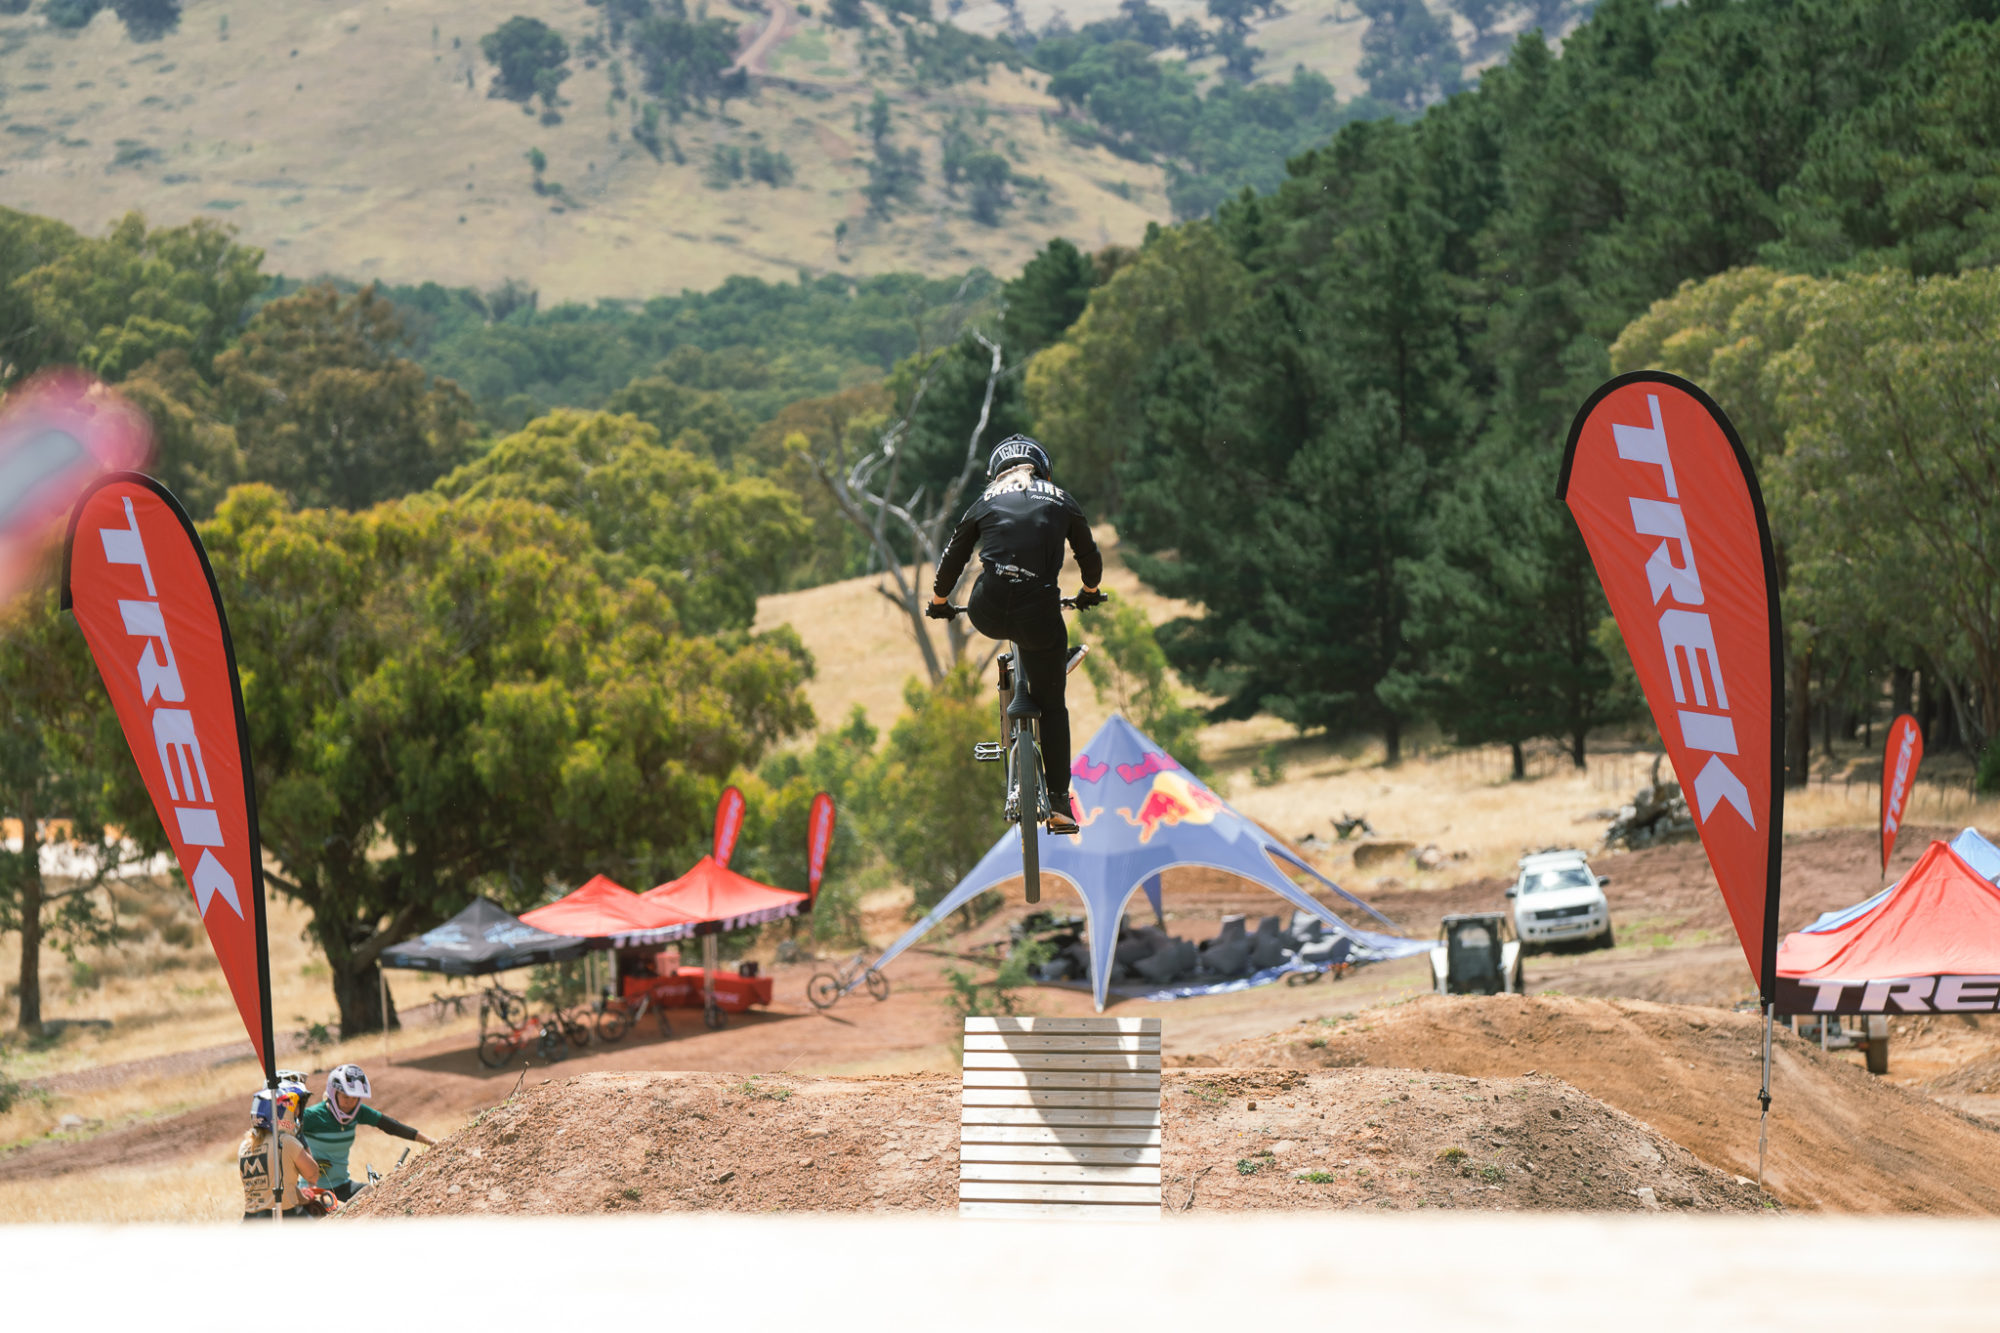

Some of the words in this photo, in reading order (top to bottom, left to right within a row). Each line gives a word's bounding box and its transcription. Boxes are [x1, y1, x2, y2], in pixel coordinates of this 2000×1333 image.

[999, 444, 1033, 459] IGNITE
[1612, 394, 1756, 831] TREK
[100, 496, 244, 921] TREK
[1884, 720, 1916, 834] TREK
[1799, 976, 2000, 1012] TRE
